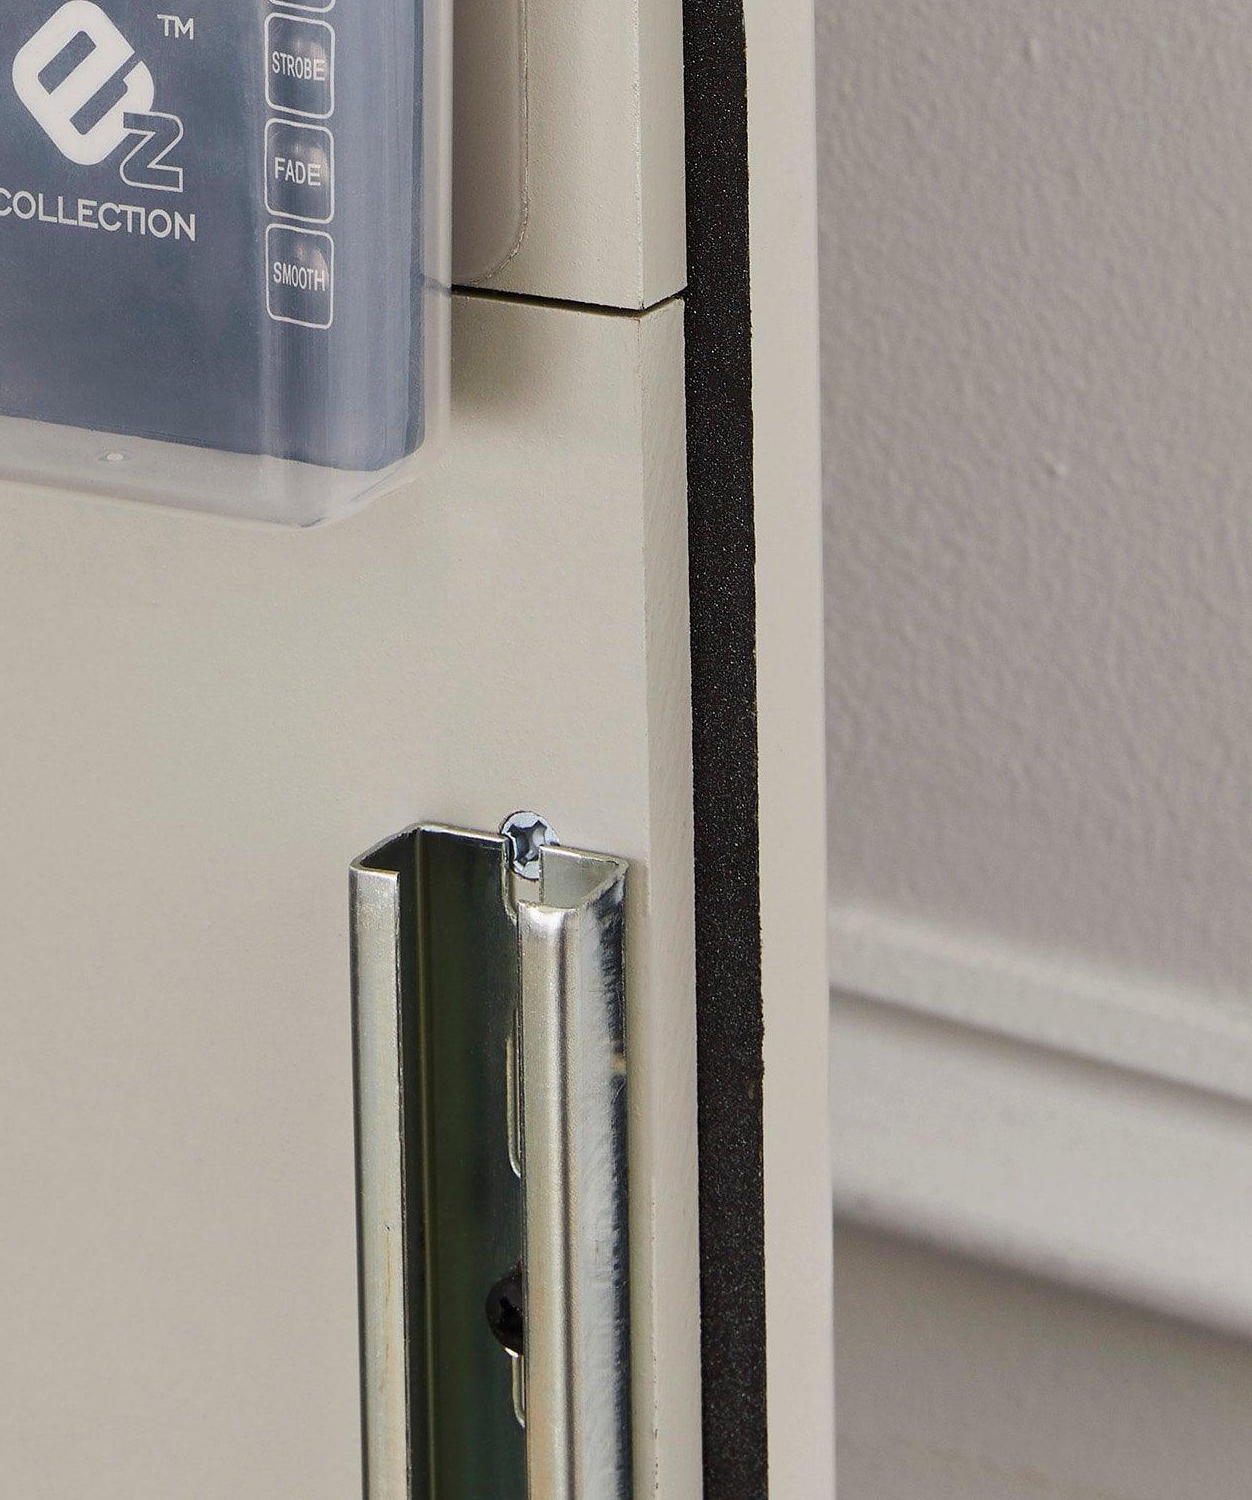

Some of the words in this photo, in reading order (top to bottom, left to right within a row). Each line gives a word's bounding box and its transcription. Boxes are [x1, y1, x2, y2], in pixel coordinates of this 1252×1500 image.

[157, 13, 195, 40] TM
[272, 51, 326, 82] STROBE
[274, 156, 322, 187] FADE
[273, 261, 326, 292] SMOOTH
